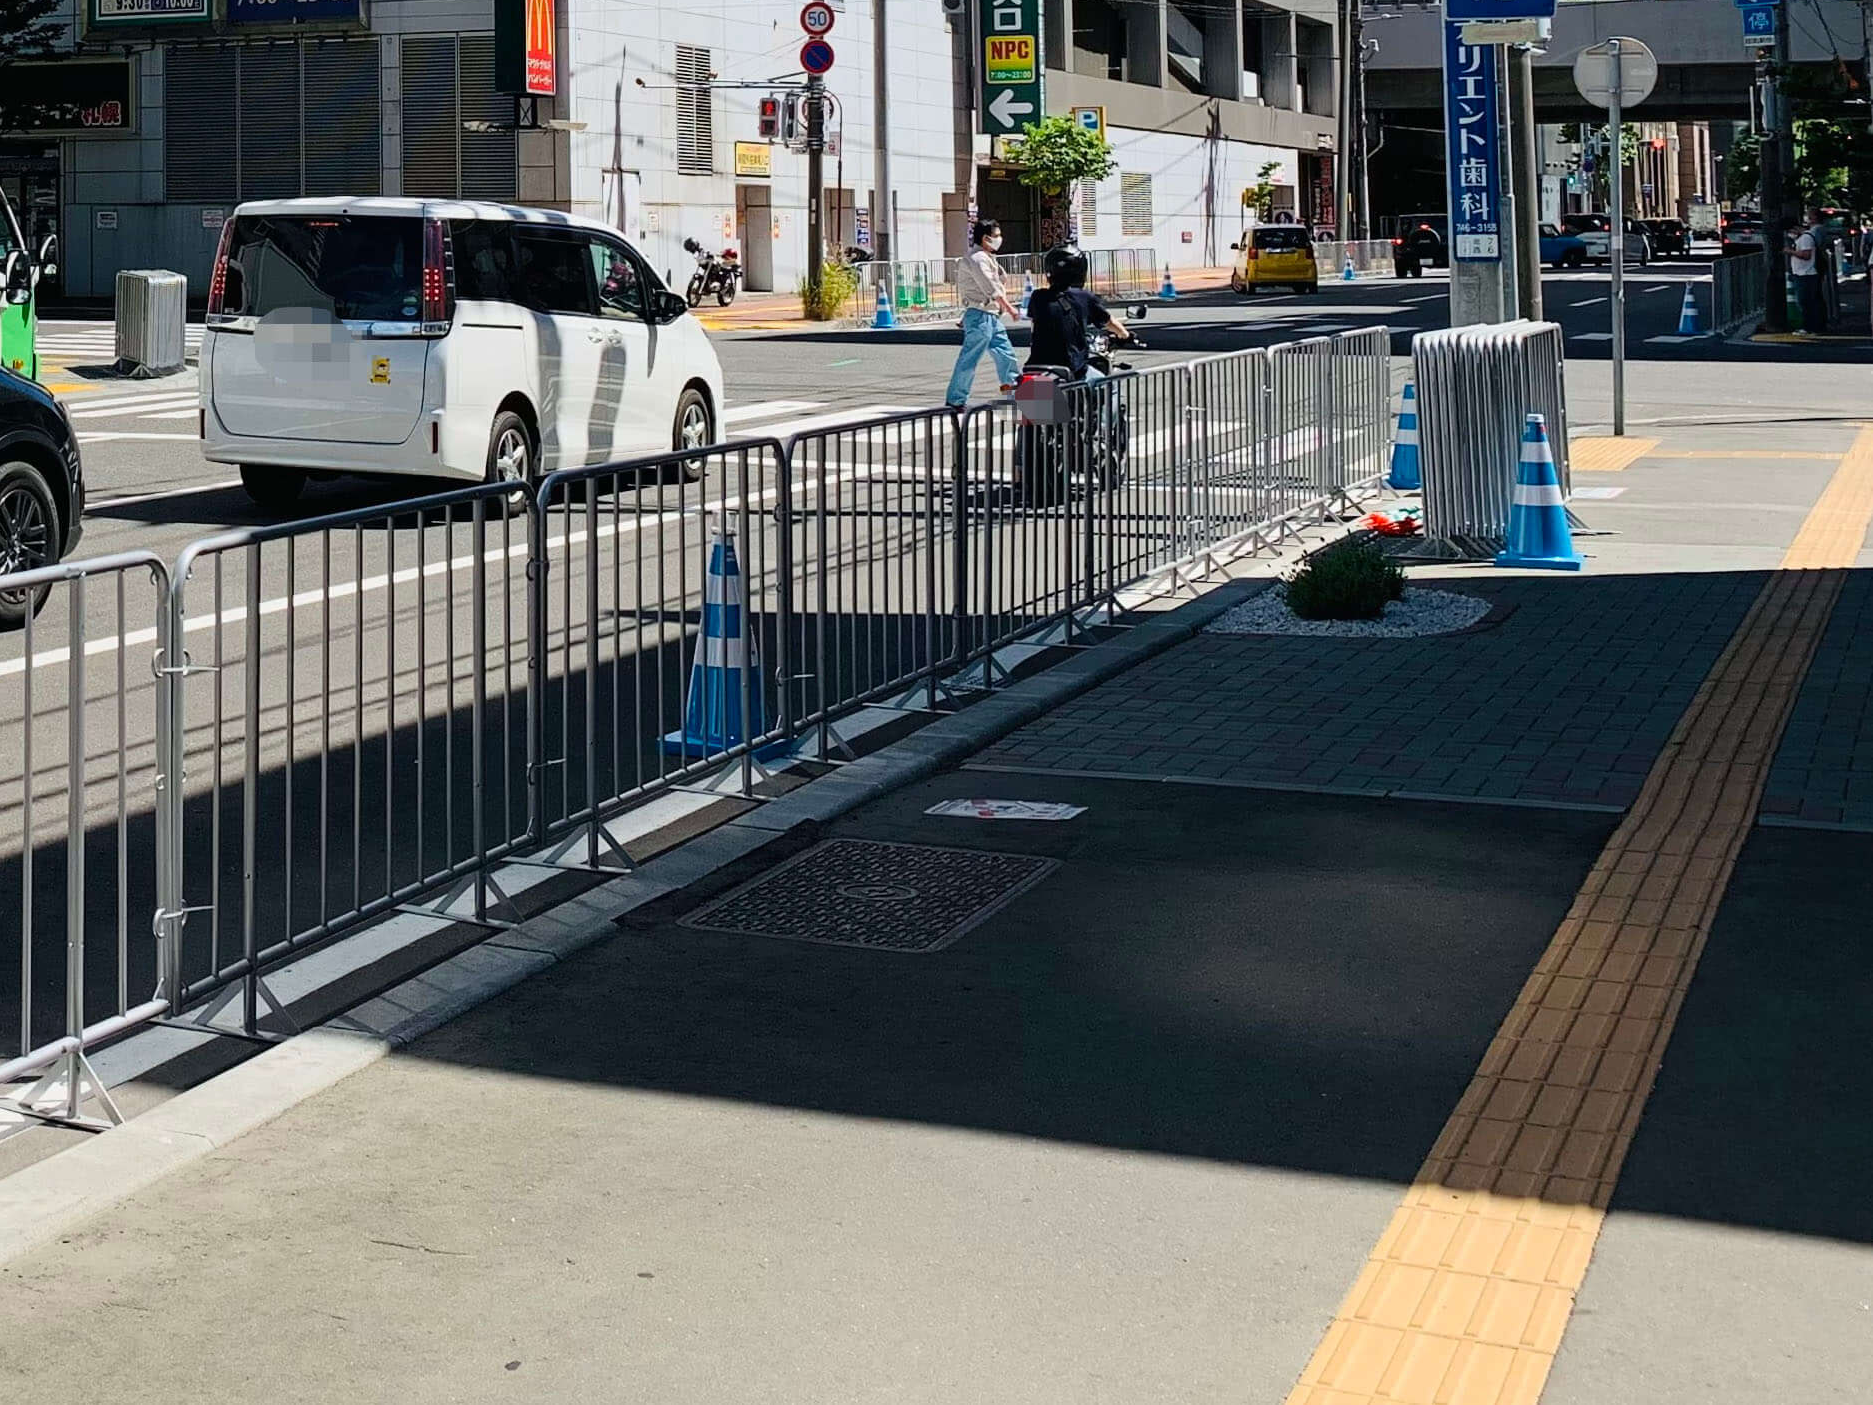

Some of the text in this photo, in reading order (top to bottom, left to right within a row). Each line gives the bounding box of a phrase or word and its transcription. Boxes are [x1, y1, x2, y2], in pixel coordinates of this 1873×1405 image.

[807, 11, 827, 27] 50
[991, 41, 1030, 60] NPC
[1453, 22, 1490, 221] リエント歯科
